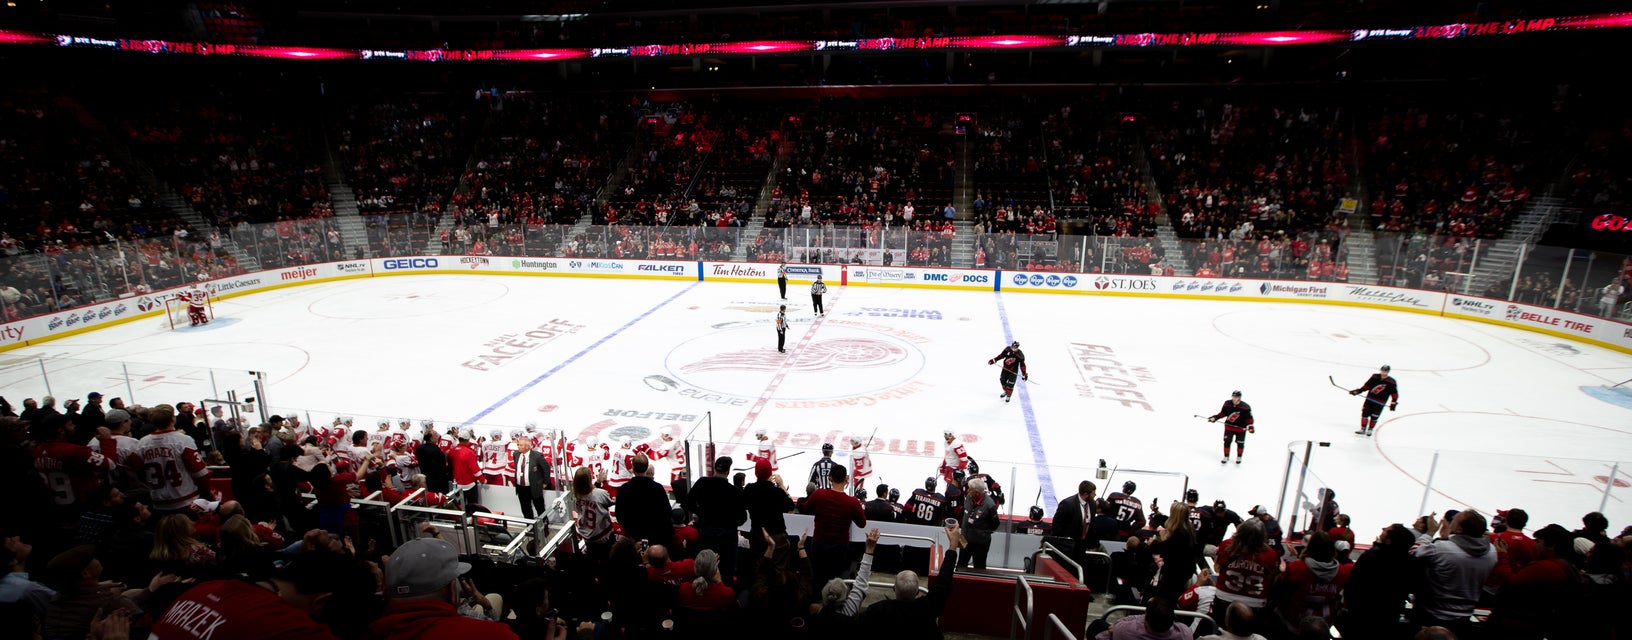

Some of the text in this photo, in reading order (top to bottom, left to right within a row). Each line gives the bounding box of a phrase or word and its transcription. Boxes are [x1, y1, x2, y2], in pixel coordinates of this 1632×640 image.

[1468, 22, 1499, 34] THE
[1504, 18, 1555, 34] LAMP
[894, 38, 914, 48] THE
[918, 38, 950, 48] LAMP
[1156, 34, 1178, 44] THE
[1182, 33, 1217, 44] LAMP
[167, 42, 194, 53] THE
[197, 44, 235, 54] LAMP
[662, 45, 680, 55] THE
[683, 44, 710, 54] LAMP
[443, 50, 461, 60] THE
[464, 50, 493, 60] LAMP
[384, 258, 438, 270] GEICO
[460, 256, 490, 266] HOCKEYTOWN
[521, 260, 557, 270] Huntington
[281, 266, 317, 280] meijer
[713, 264, 766, 277] Tim Hortons
[924, 273, 948, 281] DMC
[218, 277, 261, 292] Little Caesars
[1111, 278, 1156, 290] ST. JOE'S
[1273, 285, 1307, 294] Michigan
[1462, 300, 1494, 310] NHL.TV
[1520, 312, 1594, 333] BELLE TIRE
[460, 318, 576, 372] FACE-OFF
[484, 334, 518, 347] NHL
[1070, 342, 1154, 412] FACE-OFF
[678, 380, 936, 408] Little Caesars arena
[603, 408, 698, 422] BELFOR
[142, 447, 174, 461] MRAZEK
[485, 452, 497, 464] 14
[145, 460, 183, 489] 34
[917, 503, 934, 521] 86
[1116, 505, 1135, 521] 57
[1310, 584, 1337, 594] LARKIN
[161, 600, 226, 640] MRAZEK
